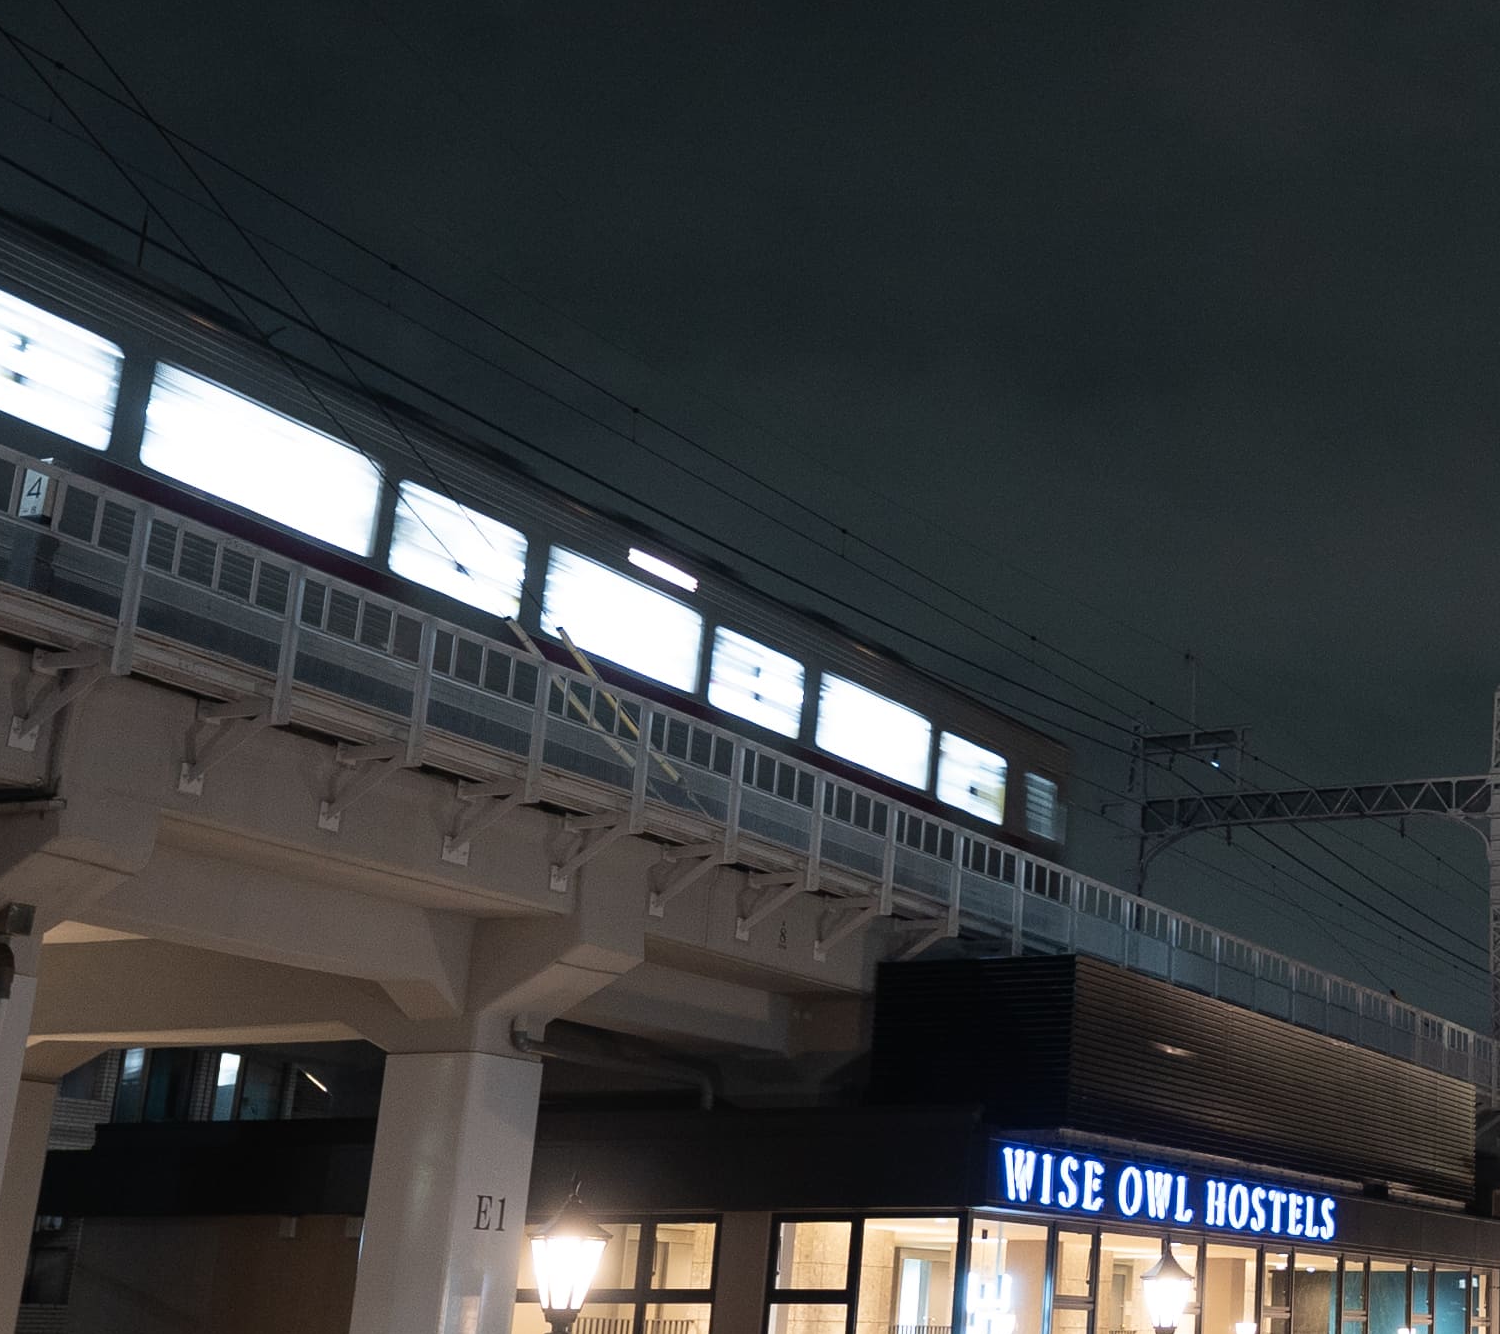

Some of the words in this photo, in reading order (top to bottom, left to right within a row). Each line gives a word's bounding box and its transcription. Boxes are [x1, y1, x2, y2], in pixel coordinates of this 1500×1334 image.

[26, 476, 43, 498] 4
[1002, 1146, 1104, 1212] WISE
[1118, 1165, 1194, 1224] OWL
[1205, 1179, 1337, 1241] HOSTELS
[473, 1194, 506, 1232] E1
